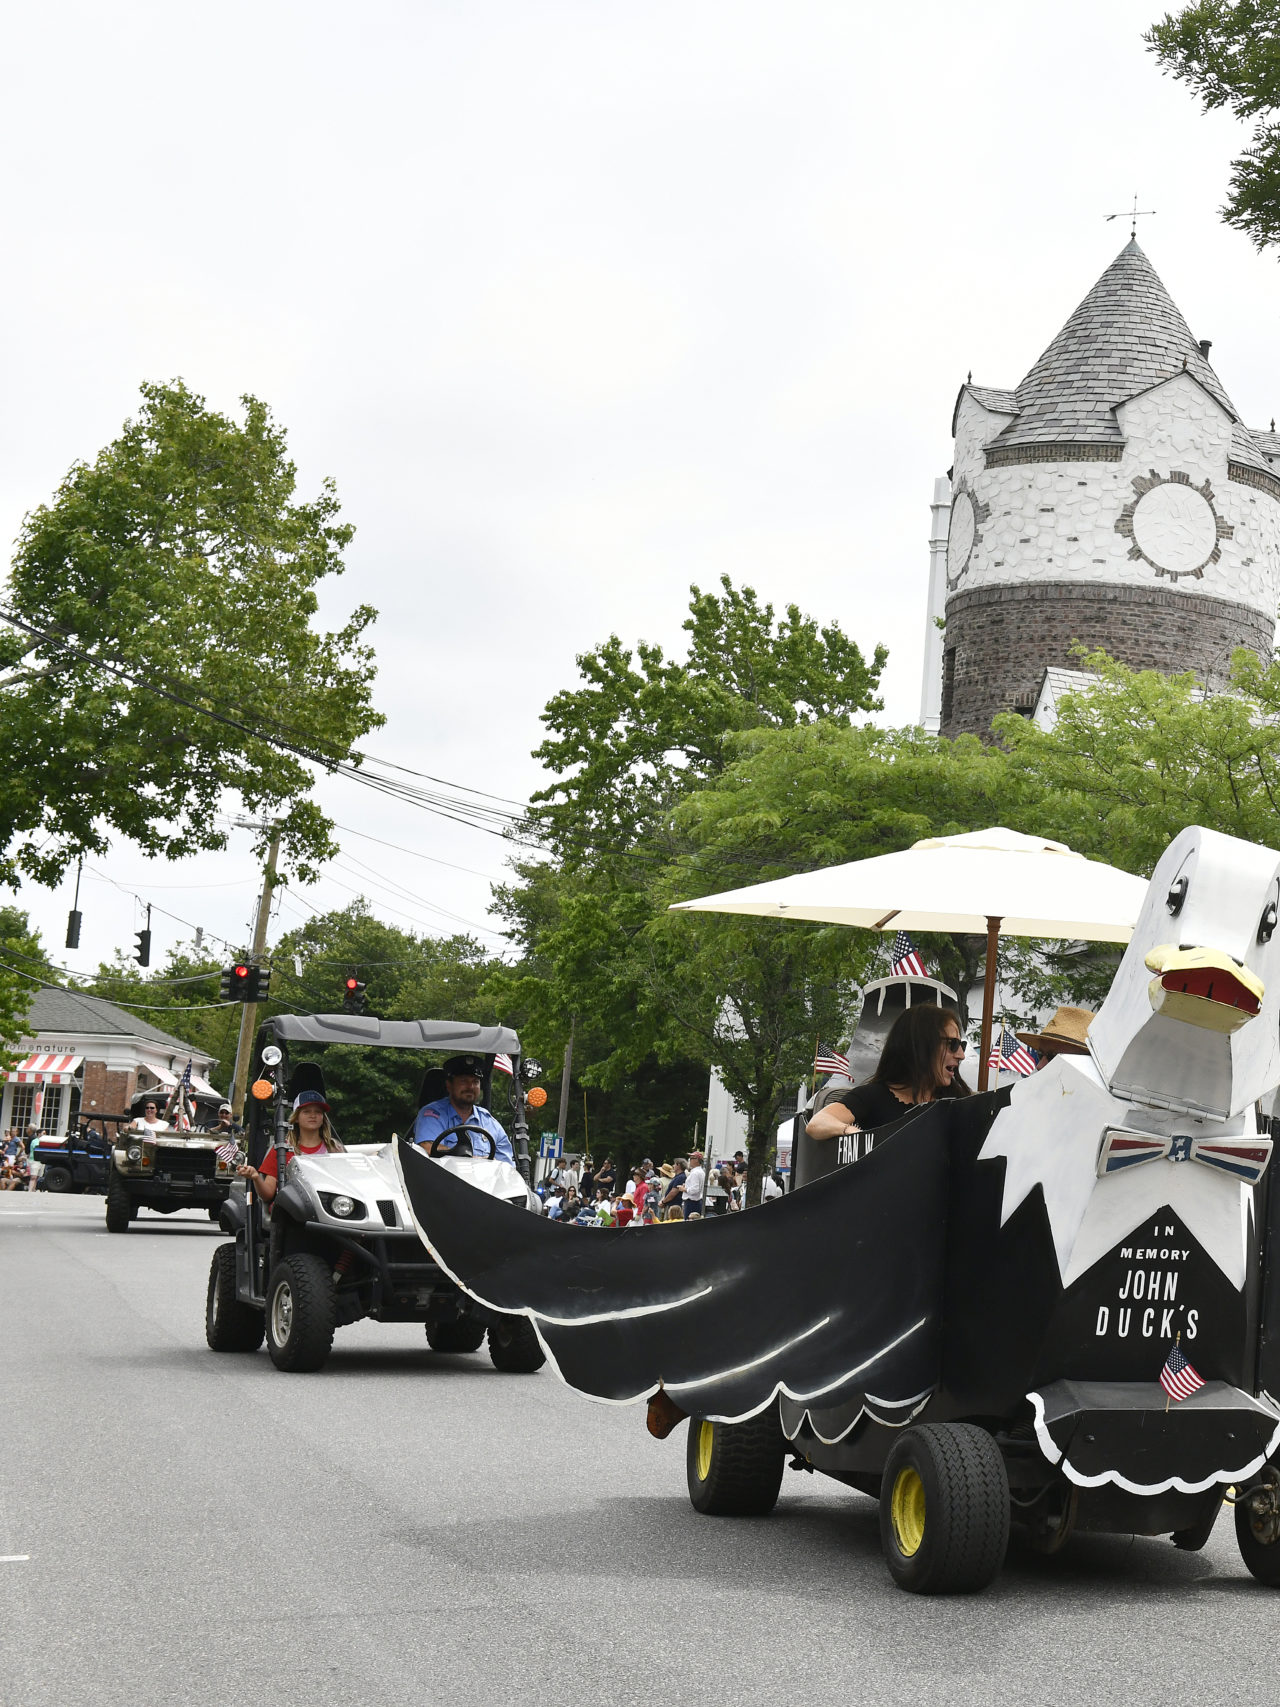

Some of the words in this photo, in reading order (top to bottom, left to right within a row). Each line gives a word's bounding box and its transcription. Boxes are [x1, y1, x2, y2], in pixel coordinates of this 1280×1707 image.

[1154, 1225, 1174, 1236] IN
[1120, 1247, 1190, 1260] MEMORY
[1119, 1269, 1178, 1301] JOHN
[1096, 1304, 1199, 1340] DUCK'S
